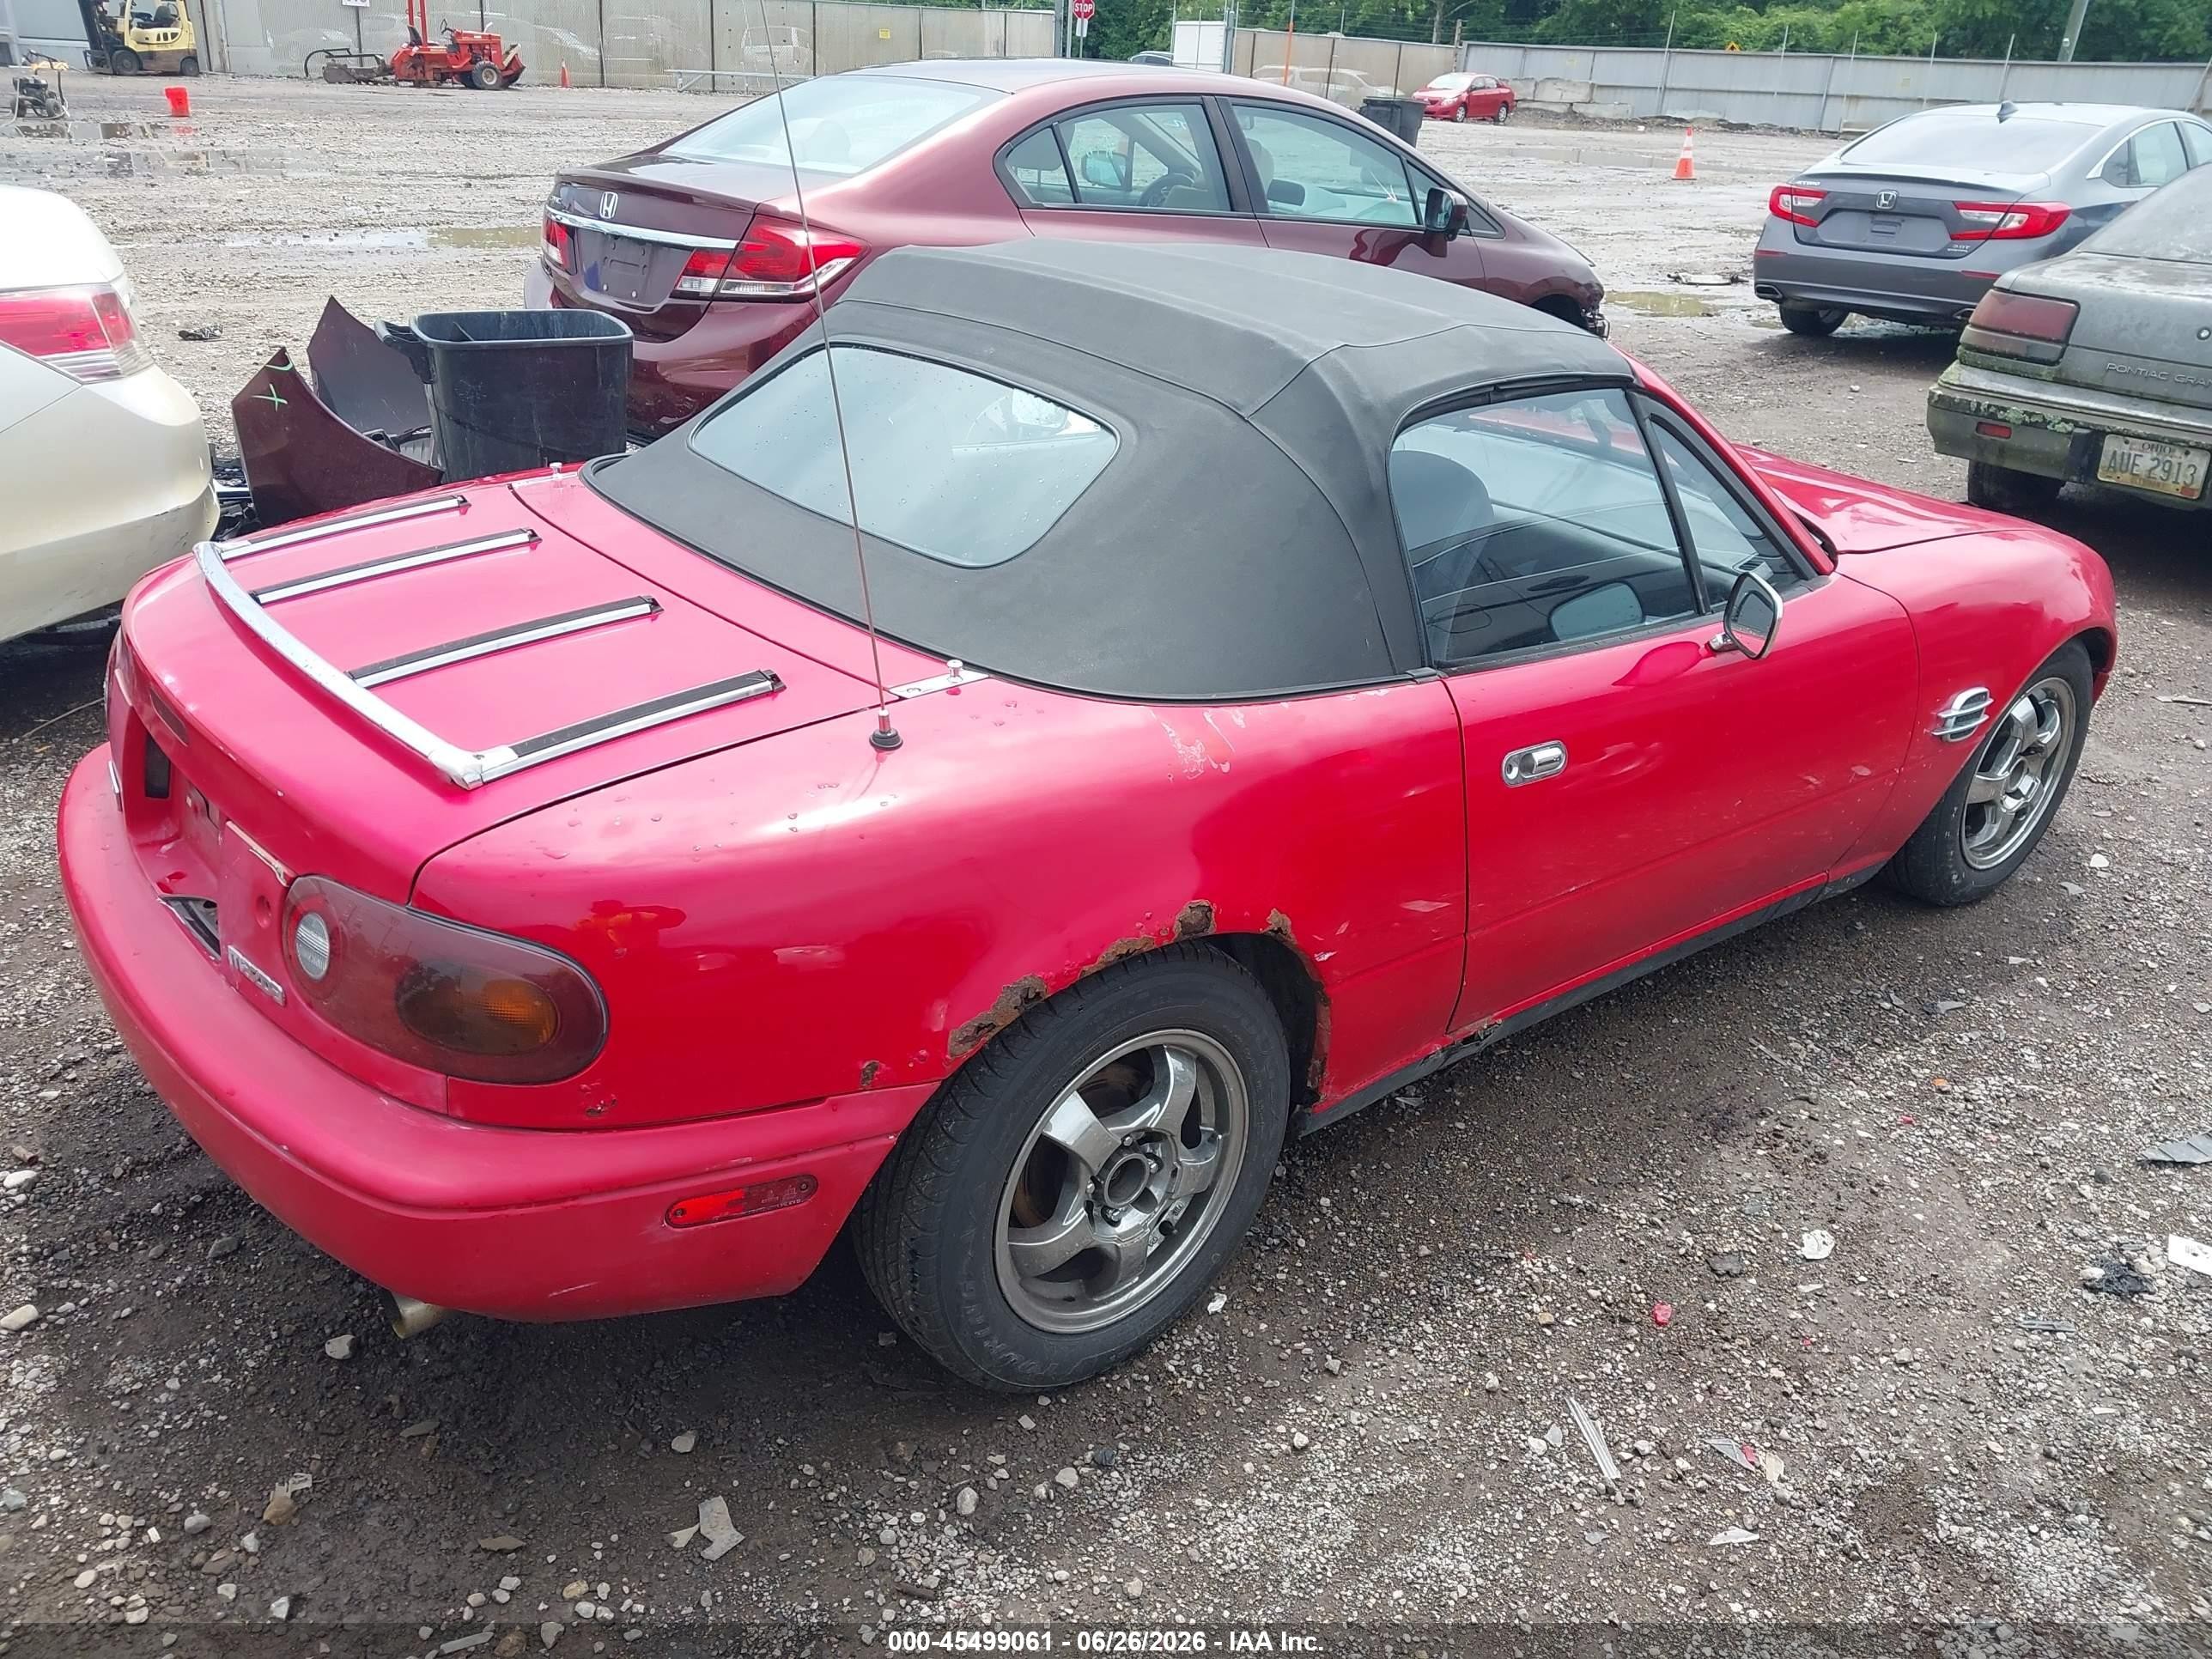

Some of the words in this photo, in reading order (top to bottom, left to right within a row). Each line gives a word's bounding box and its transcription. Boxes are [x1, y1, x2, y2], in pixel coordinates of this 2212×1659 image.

[1075, 3, 1093, 13] STOP
[2106, 362, 2169, 380] PONTIAC
[2142, 442, 2172, 454] OHIO
[2107, 450, 2144, 477] AUE
[2148, 456, 2197, 486] 2913
